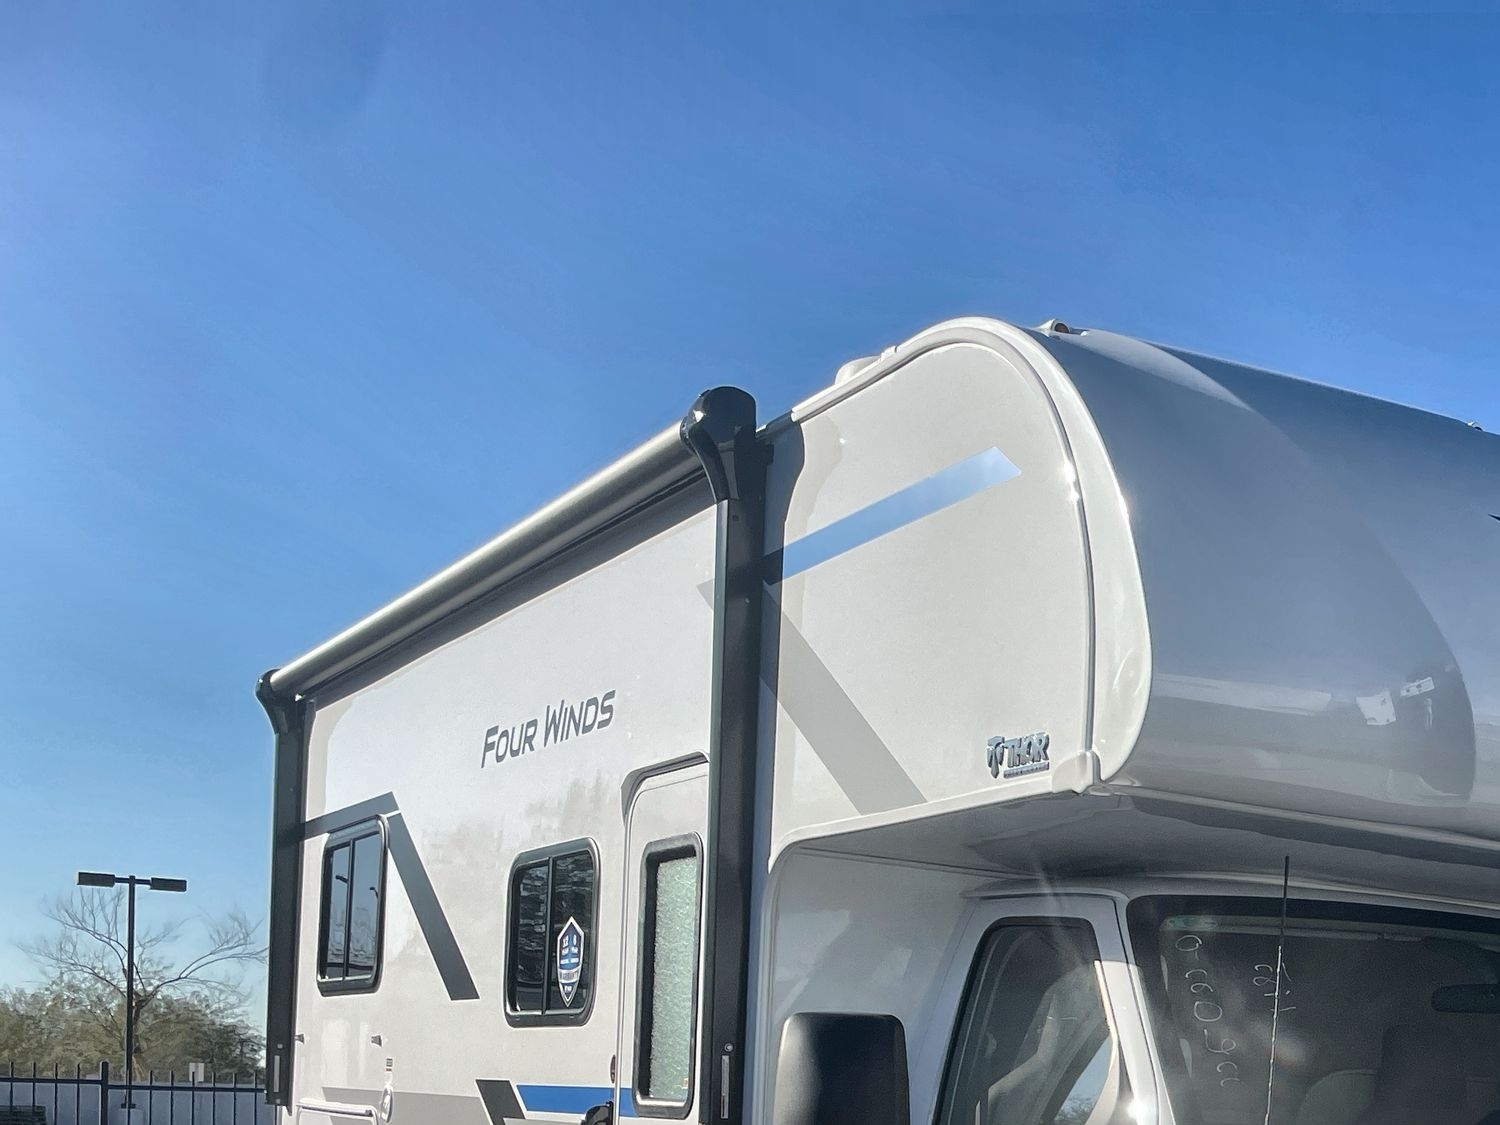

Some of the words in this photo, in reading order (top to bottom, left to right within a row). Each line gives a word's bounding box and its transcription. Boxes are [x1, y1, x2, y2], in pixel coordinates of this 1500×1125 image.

[481, 718, 539, 769] FOUR
[543, 689, 616, 748] WINDS
[1003, 731, 1050, 769] THOR
